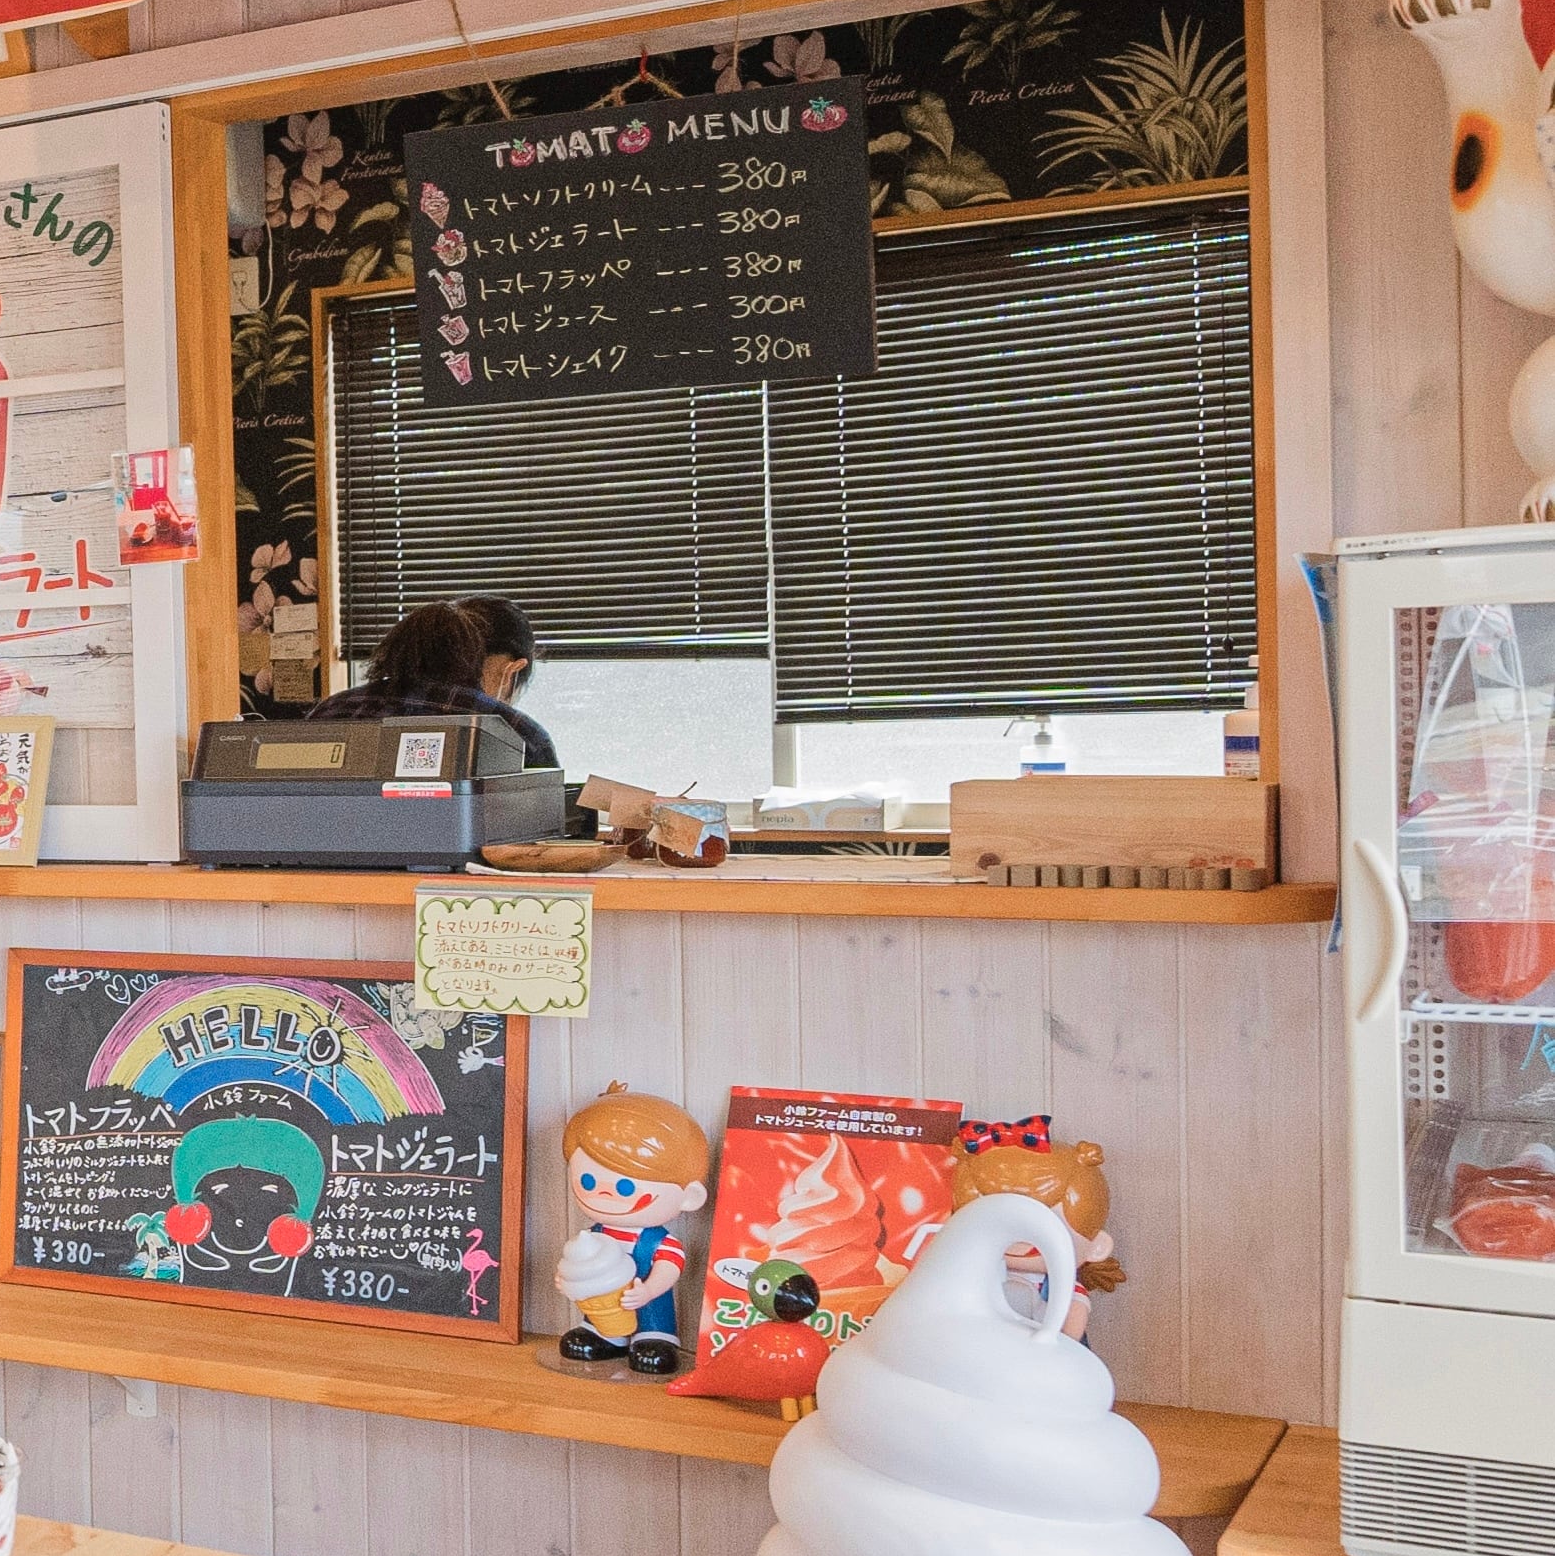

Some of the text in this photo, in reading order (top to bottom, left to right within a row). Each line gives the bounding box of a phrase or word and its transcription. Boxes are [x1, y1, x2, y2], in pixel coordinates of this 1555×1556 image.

[666, 104, 792, 147] MENU
[464, 158, 808, 221] トマトソフトクリーム 380円
[473, 208, 802, 259] トマトジェラート 380円
[479, 253, 803, 301] トマトフラッペ 380円
[479, 293, 807, 336] トマトジュース 300円
[733, 337, 811, 366] 380円
[160, 1005, 343, 1068] HELLO
[25, 1098, 177, 1139] トマトフラッペ
[202, 1085, 292, 1112] 小鈴ファーム
[783, 1104, 897, 1124] 小鈴ファーム自家製の
[331, 1126, 498, 1177] トマトジェラート
